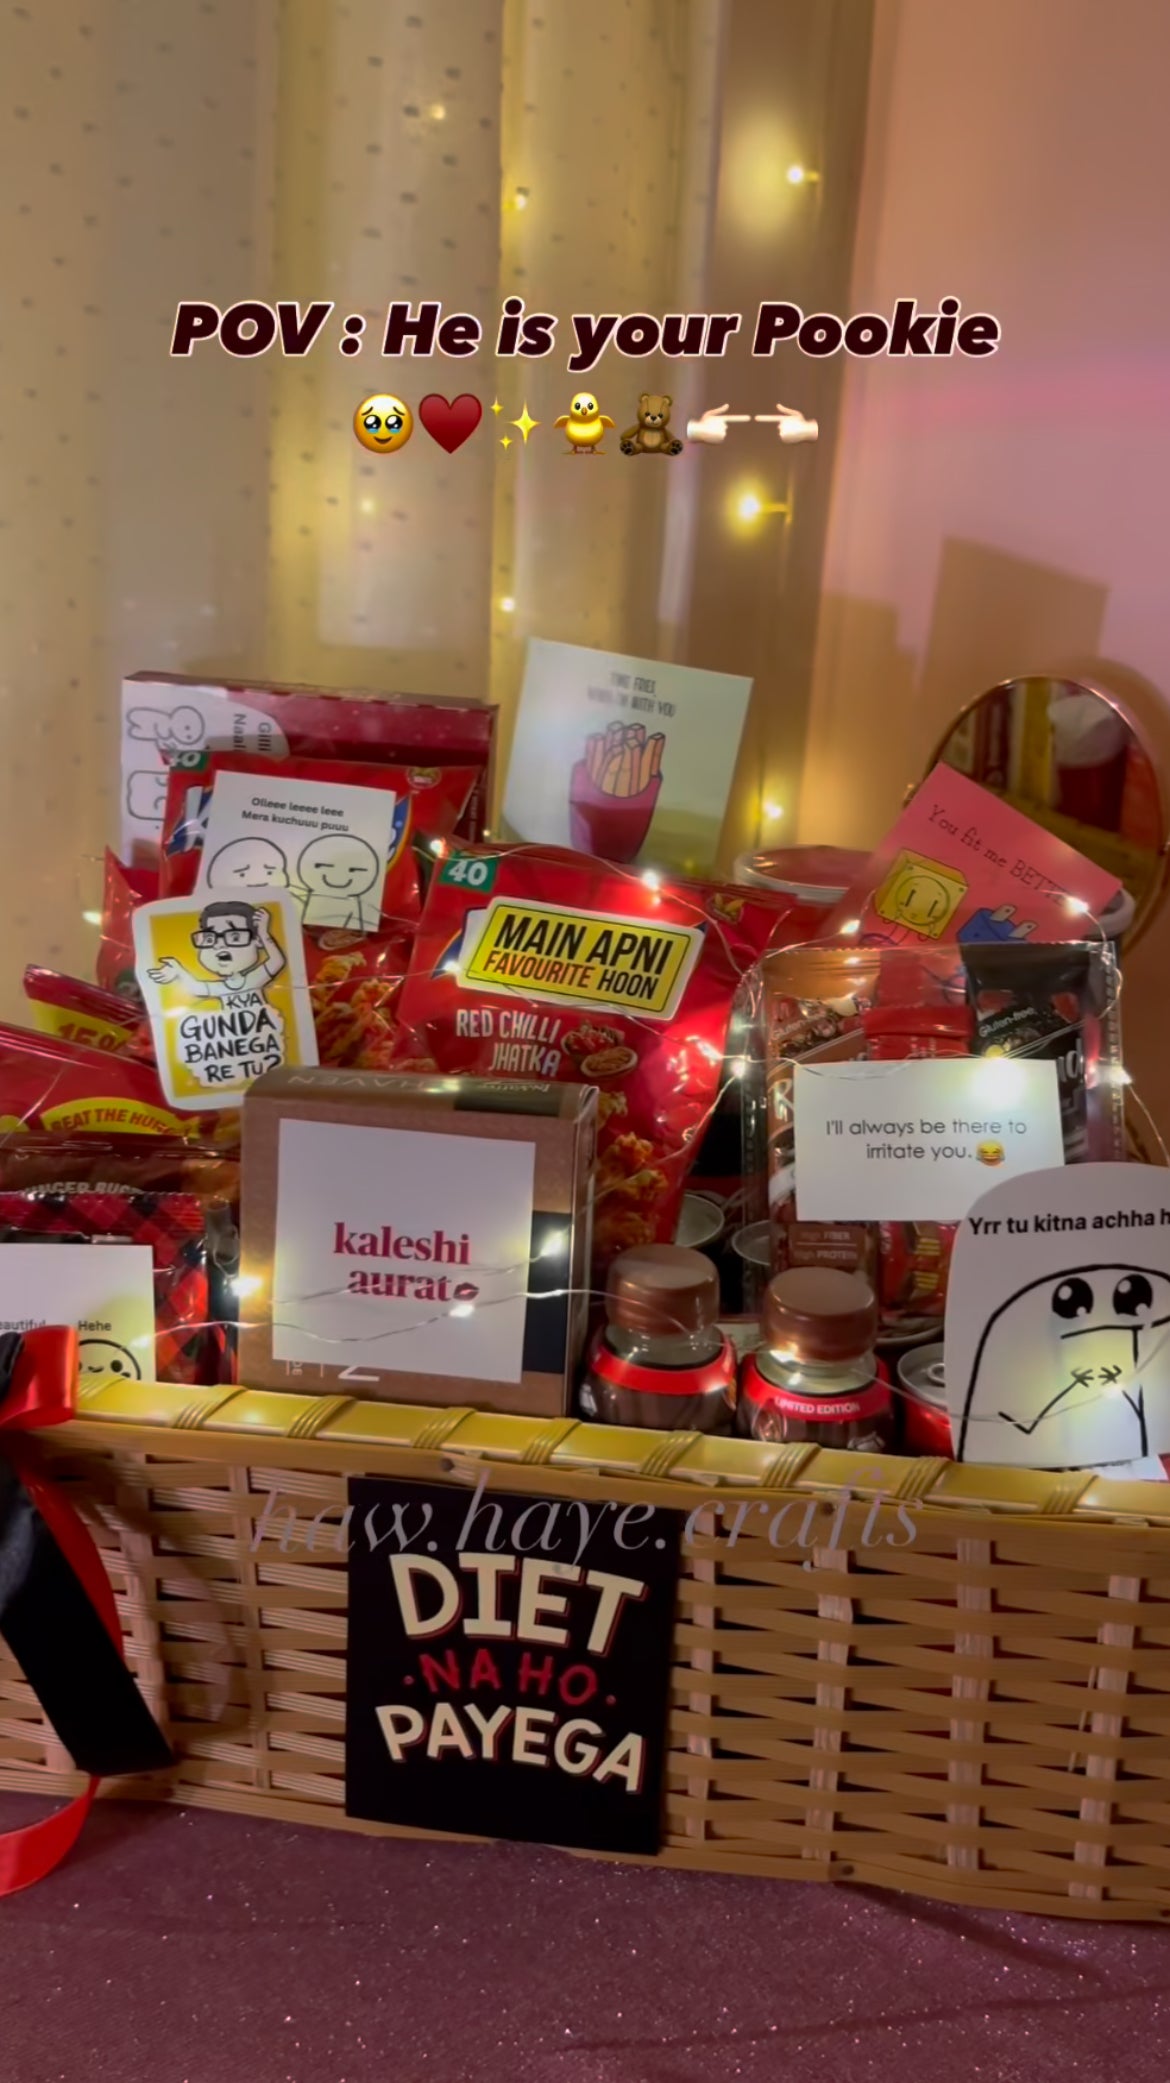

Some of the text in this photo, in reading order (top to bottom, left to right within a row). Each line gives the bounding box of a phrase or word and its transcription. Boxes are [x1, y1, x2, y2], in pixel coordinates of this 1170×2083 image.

[241, 811, 270, 822] Mera
[928, 804, 959, 836] You
[960, 827, 982, 851] fit
[984, 849, 1007, 868] me
[448, 860, 489, 886] 40
[494, 914, 674, 975] MAIN APNI
[483, 950, 660, 1000] FAVOURITE HOON
[226, 992, 264, 1009] KYA
[180, 1008, 277, 1041] GUNDA
[456, 1008, 562, 1044] RED CHILLI
[184, 1034, 281, 1063] BANEGA
[489, 1043, 562, 1078] JHATKA
[204, 1064, 236, 1083] RE
[94, 1108, 129, 1122] THE
[826, 1118, 1027, 1137] I'll always be there to
[866, 1143, 973, 1162] irritate you.
[968, 1217, 1002, 1235] Yrr
[1006, 1217, 1029, 1234] tu
[1034, 1213, 1088, 1233] kitna
[1092, 1209, 1156, 1229] achha
[333, 1222, 471, 1265] kaleshi
[348, 1269, 453, 1302] aurat
[77, 1320, 112, 1331] Hehe
[816, 1401, 861, 1415] EDITION
[389, 1552, 649, 1657] DIET
[418, 1648, 599, 1706] NA HO
[374, 1701, 647, 1795] PAYEGA
